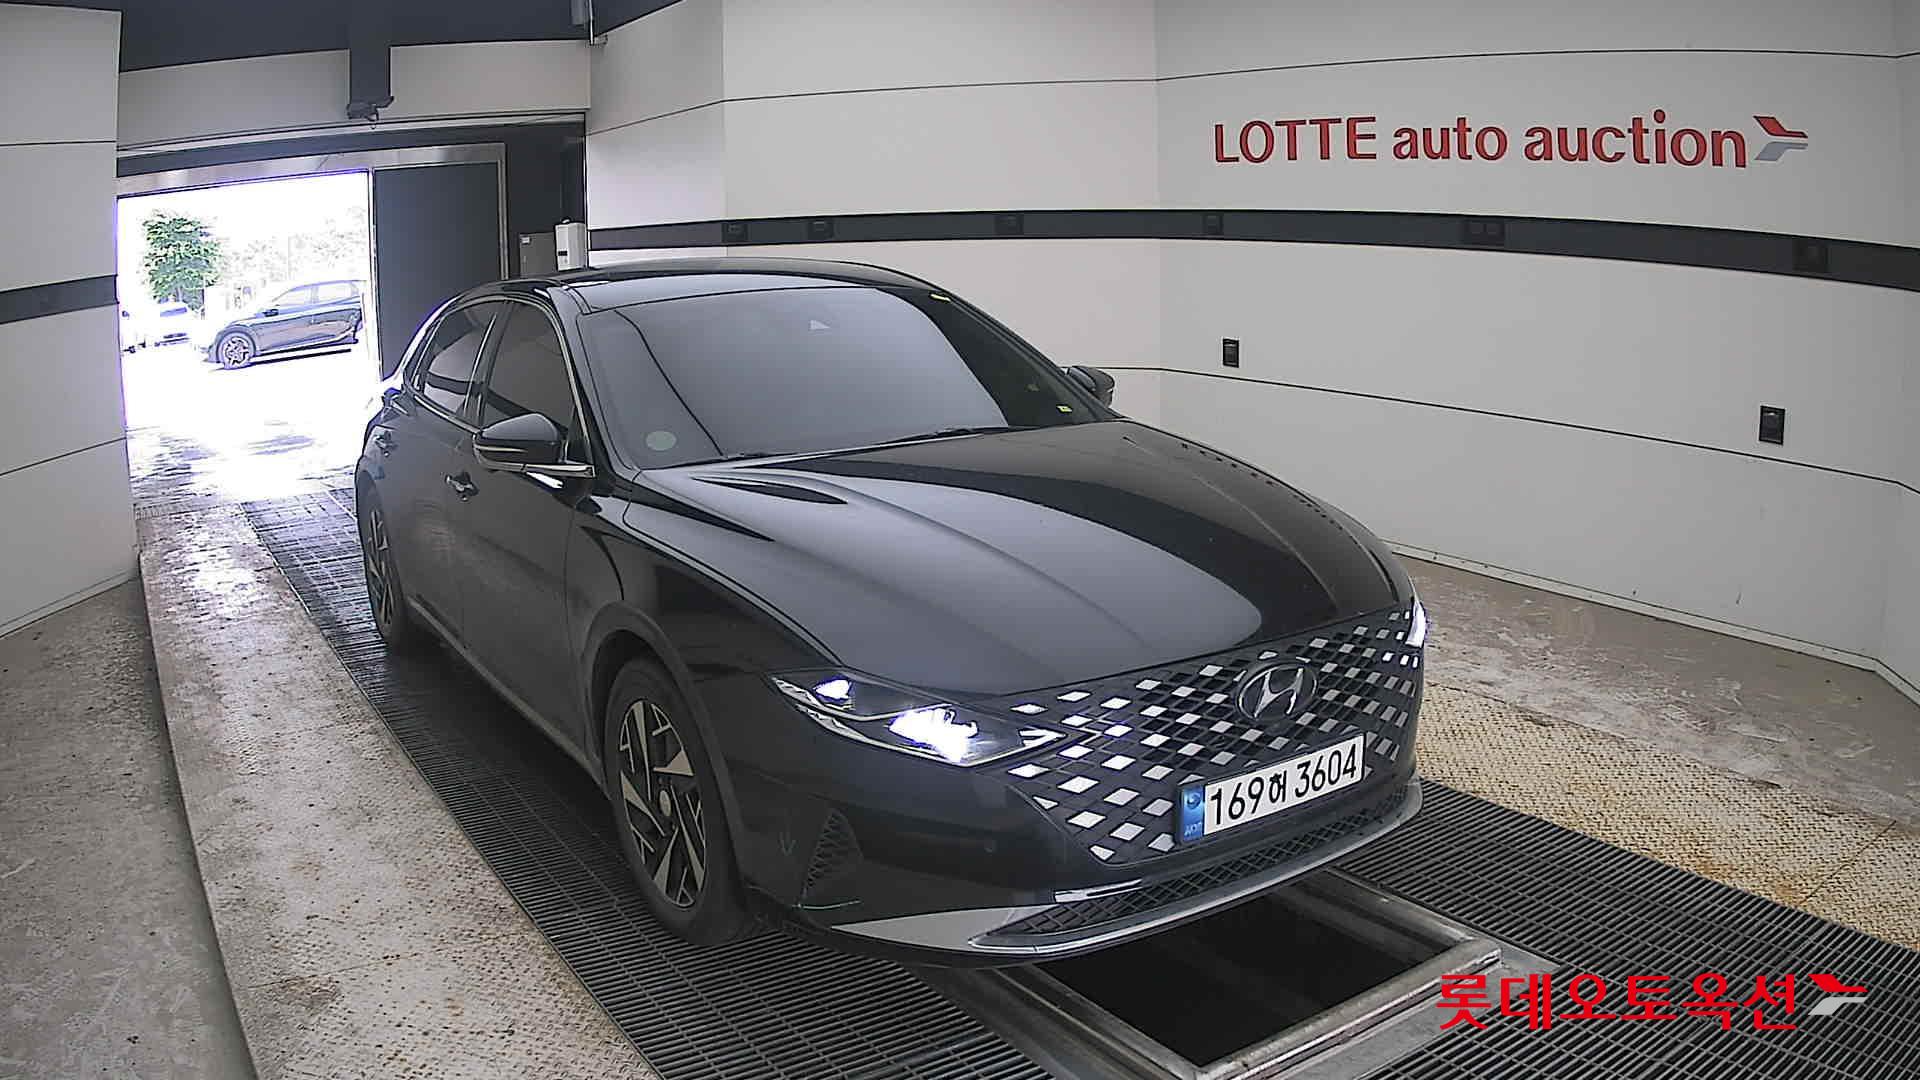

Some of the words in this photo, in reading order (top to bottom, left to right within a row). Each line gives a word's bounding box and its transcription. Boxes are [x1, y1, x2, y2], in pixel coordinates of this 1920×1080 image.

[1214, 116, 1377, 162] LOTTE
[1393, 117, 1508, 161] auto
[1524, 110, 1747, 168] auction
[1209, 769, 1287, 825] 169허
[1295, 744, 1357, 799] 3604
